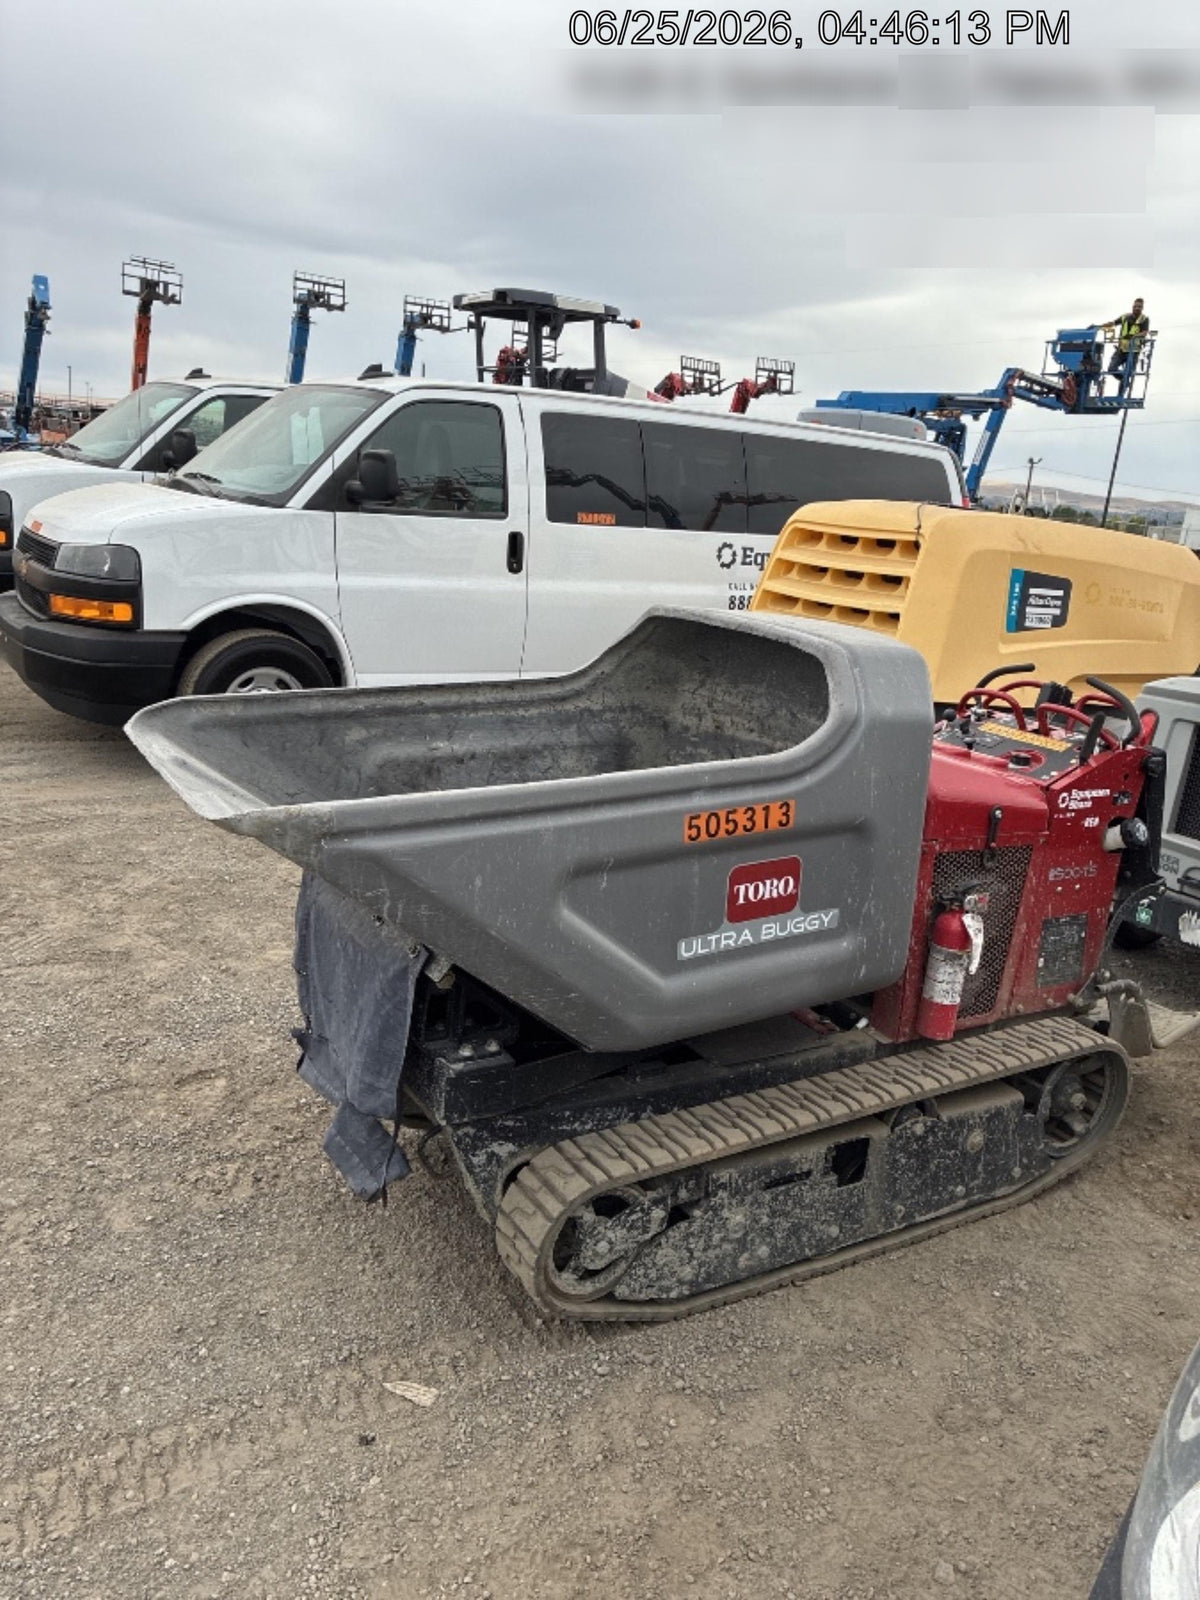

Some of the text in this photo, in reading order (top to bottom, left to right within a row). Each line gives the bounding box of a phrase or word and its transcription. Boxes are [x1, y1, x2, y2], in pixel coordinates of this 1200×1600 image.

[687, 801, 791, 841] 505313
[734, 876, 795, 905] TORO
[681, 911, 833, 957] ULTRA BUGGY
